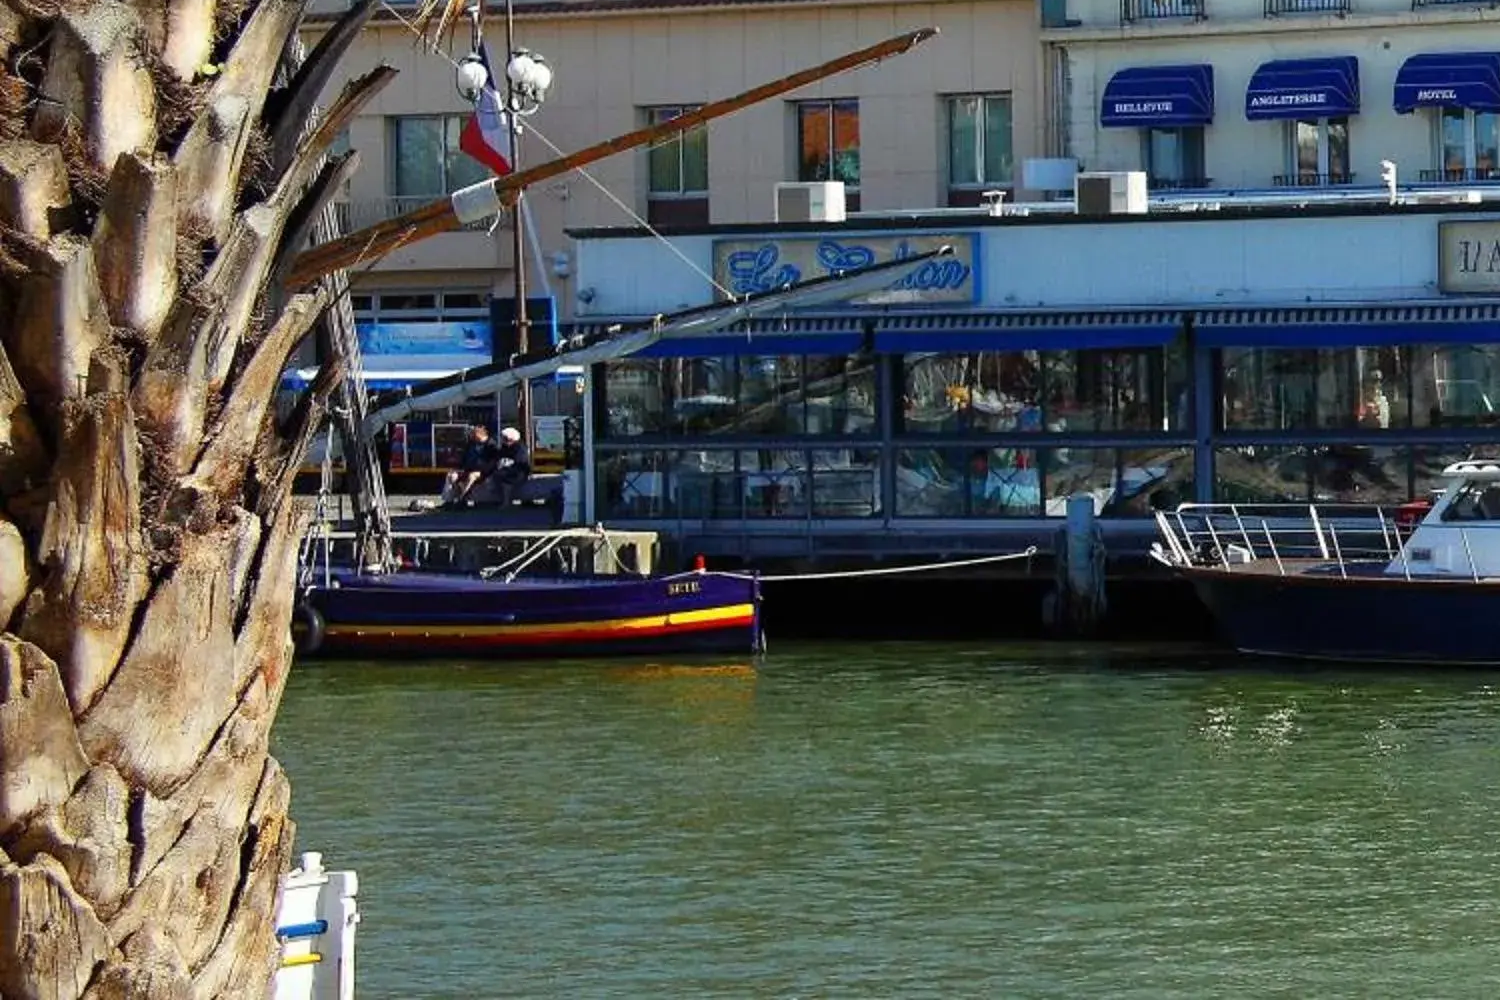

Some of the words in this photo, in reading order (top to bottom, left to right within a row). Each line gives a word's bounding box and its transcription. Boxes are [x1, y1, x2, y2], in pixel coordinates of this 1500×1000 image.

[1251, 92, 1327, 106] ANGLETERRE
[1418, 88, 1458, 101] HOTEL
[1115, 101, 1174, 113] BELLEVUE
